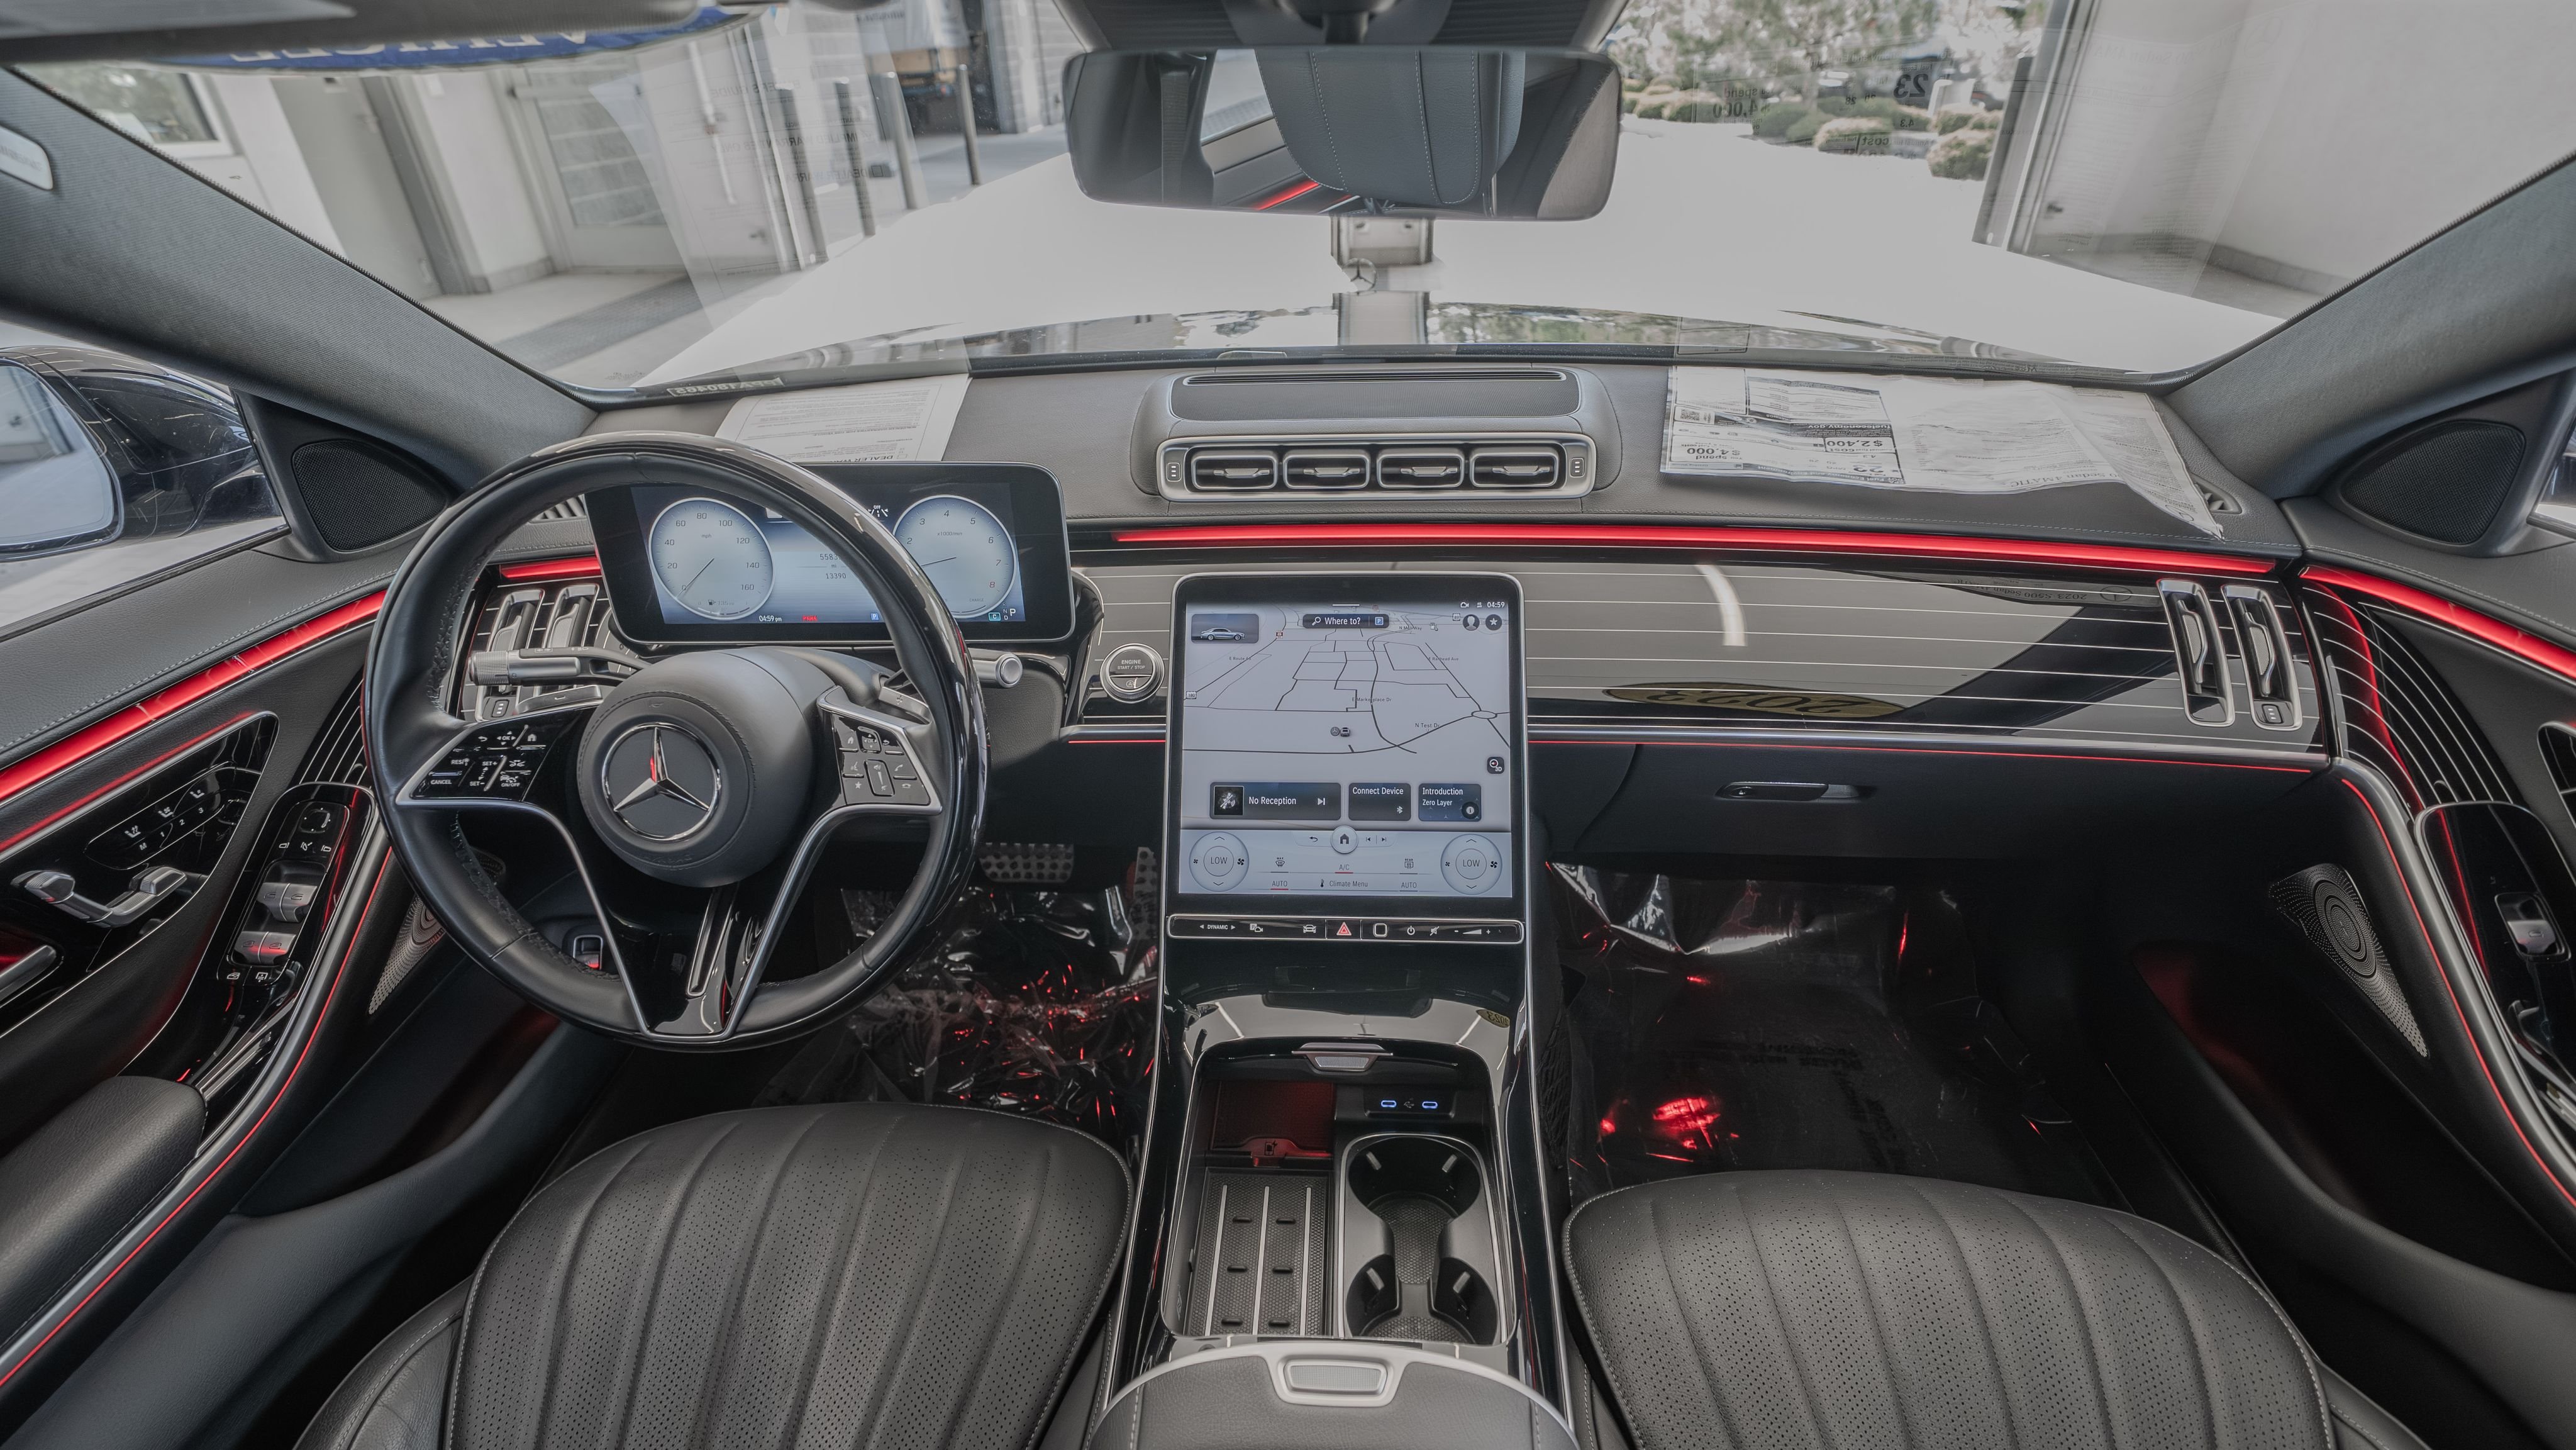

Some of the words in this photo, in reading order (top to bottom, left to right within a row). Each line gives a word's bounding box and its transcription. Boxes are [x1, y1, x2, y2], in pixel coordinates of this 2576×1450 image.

[2011, 476, 2063, 488] 4MATIC
[1009, 608, 1016, 616] P
[1352, 787, 1380, 795] Connect
[1381, 787, 1404, 795] Device
[1423, 788, 1463, 796] Introduction
[1248, 796, 1259, 805] No
[1260, 796, 1297, 807] Reception
[1436, 799, 1453, 808] Layer
[139, 842, 147, 850] M
